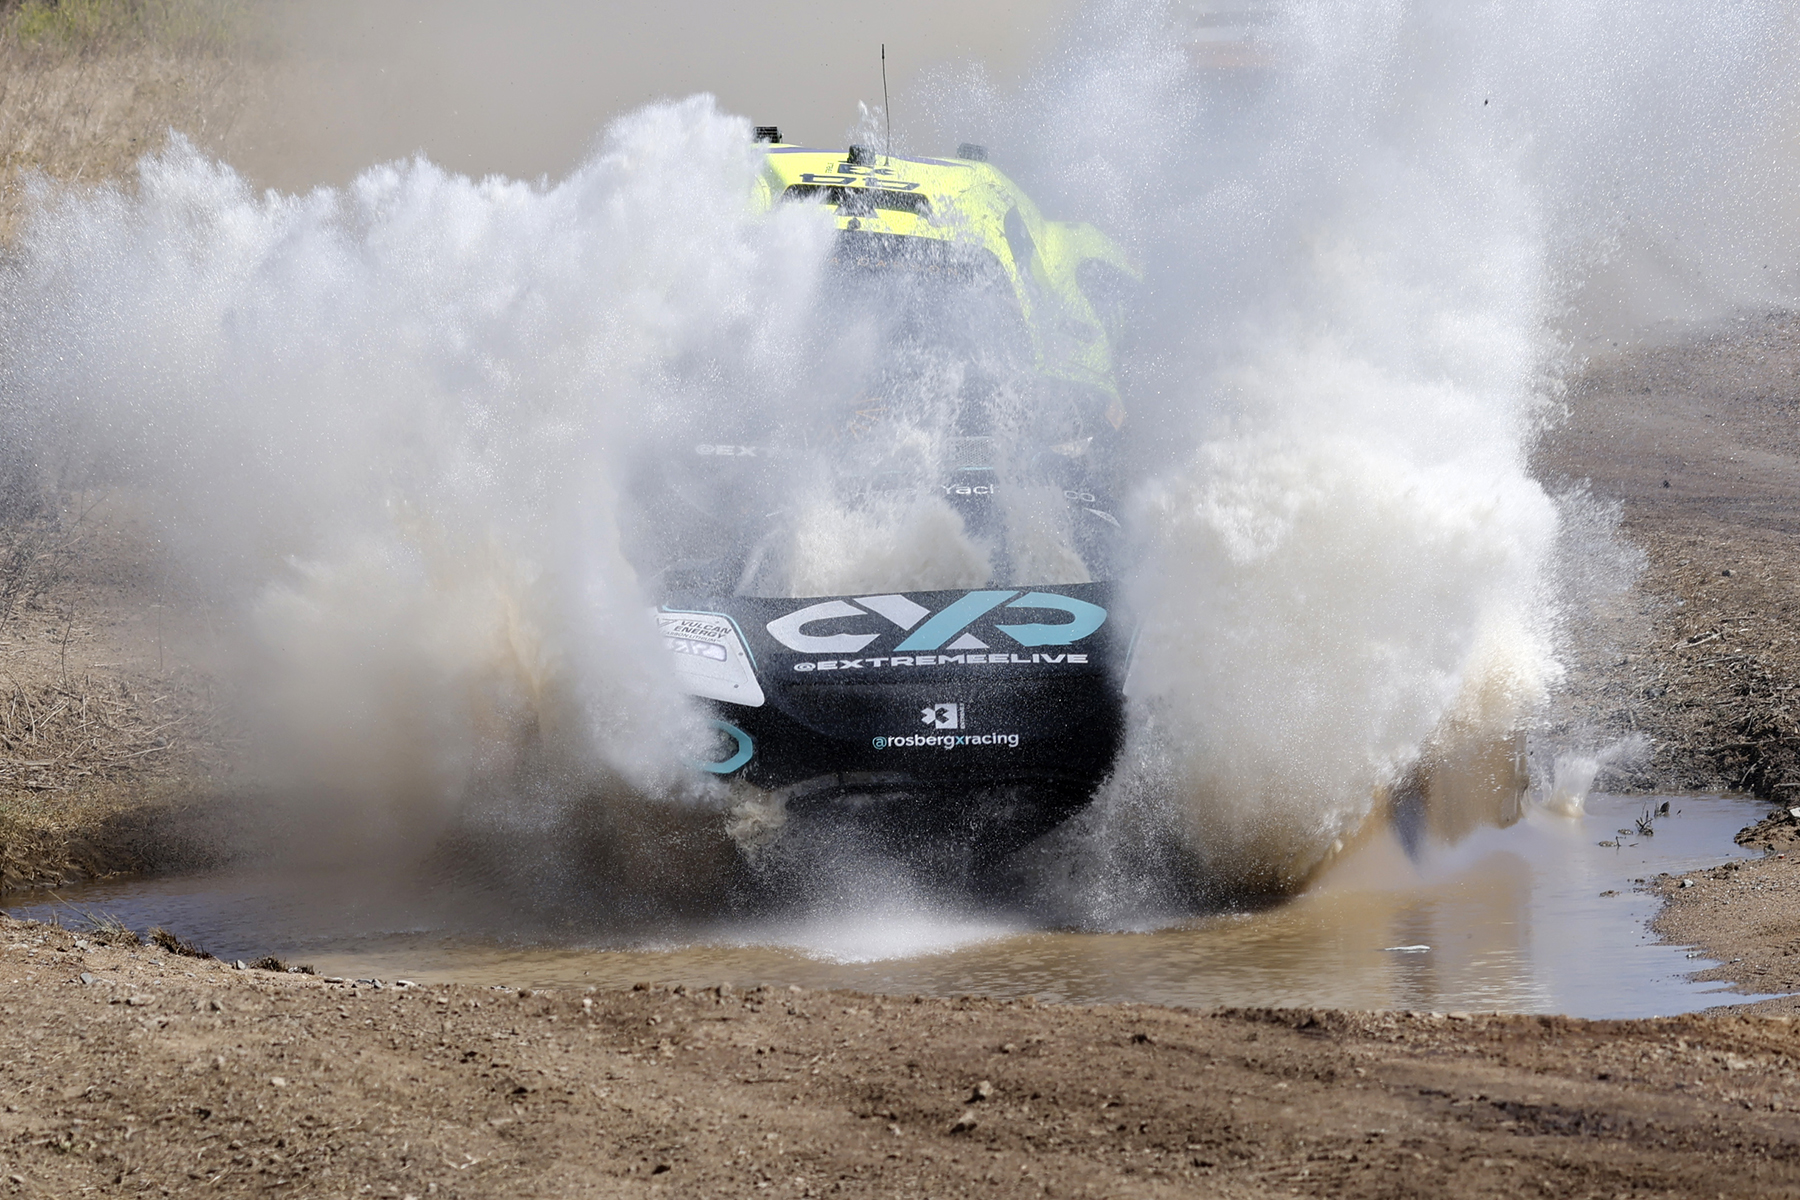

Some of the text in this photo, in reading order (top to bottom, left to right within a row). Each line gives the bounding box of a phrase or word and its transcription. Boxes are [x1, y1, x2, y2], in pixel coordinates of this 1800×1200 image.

[673, 625, 726, 639] ENERGY
[681, 620, 732, 635] VULCAN
[793, 653, 1089, 672] @EXTREMEELIVE
[872, 732, 1019, 750] @rosbergxracing
